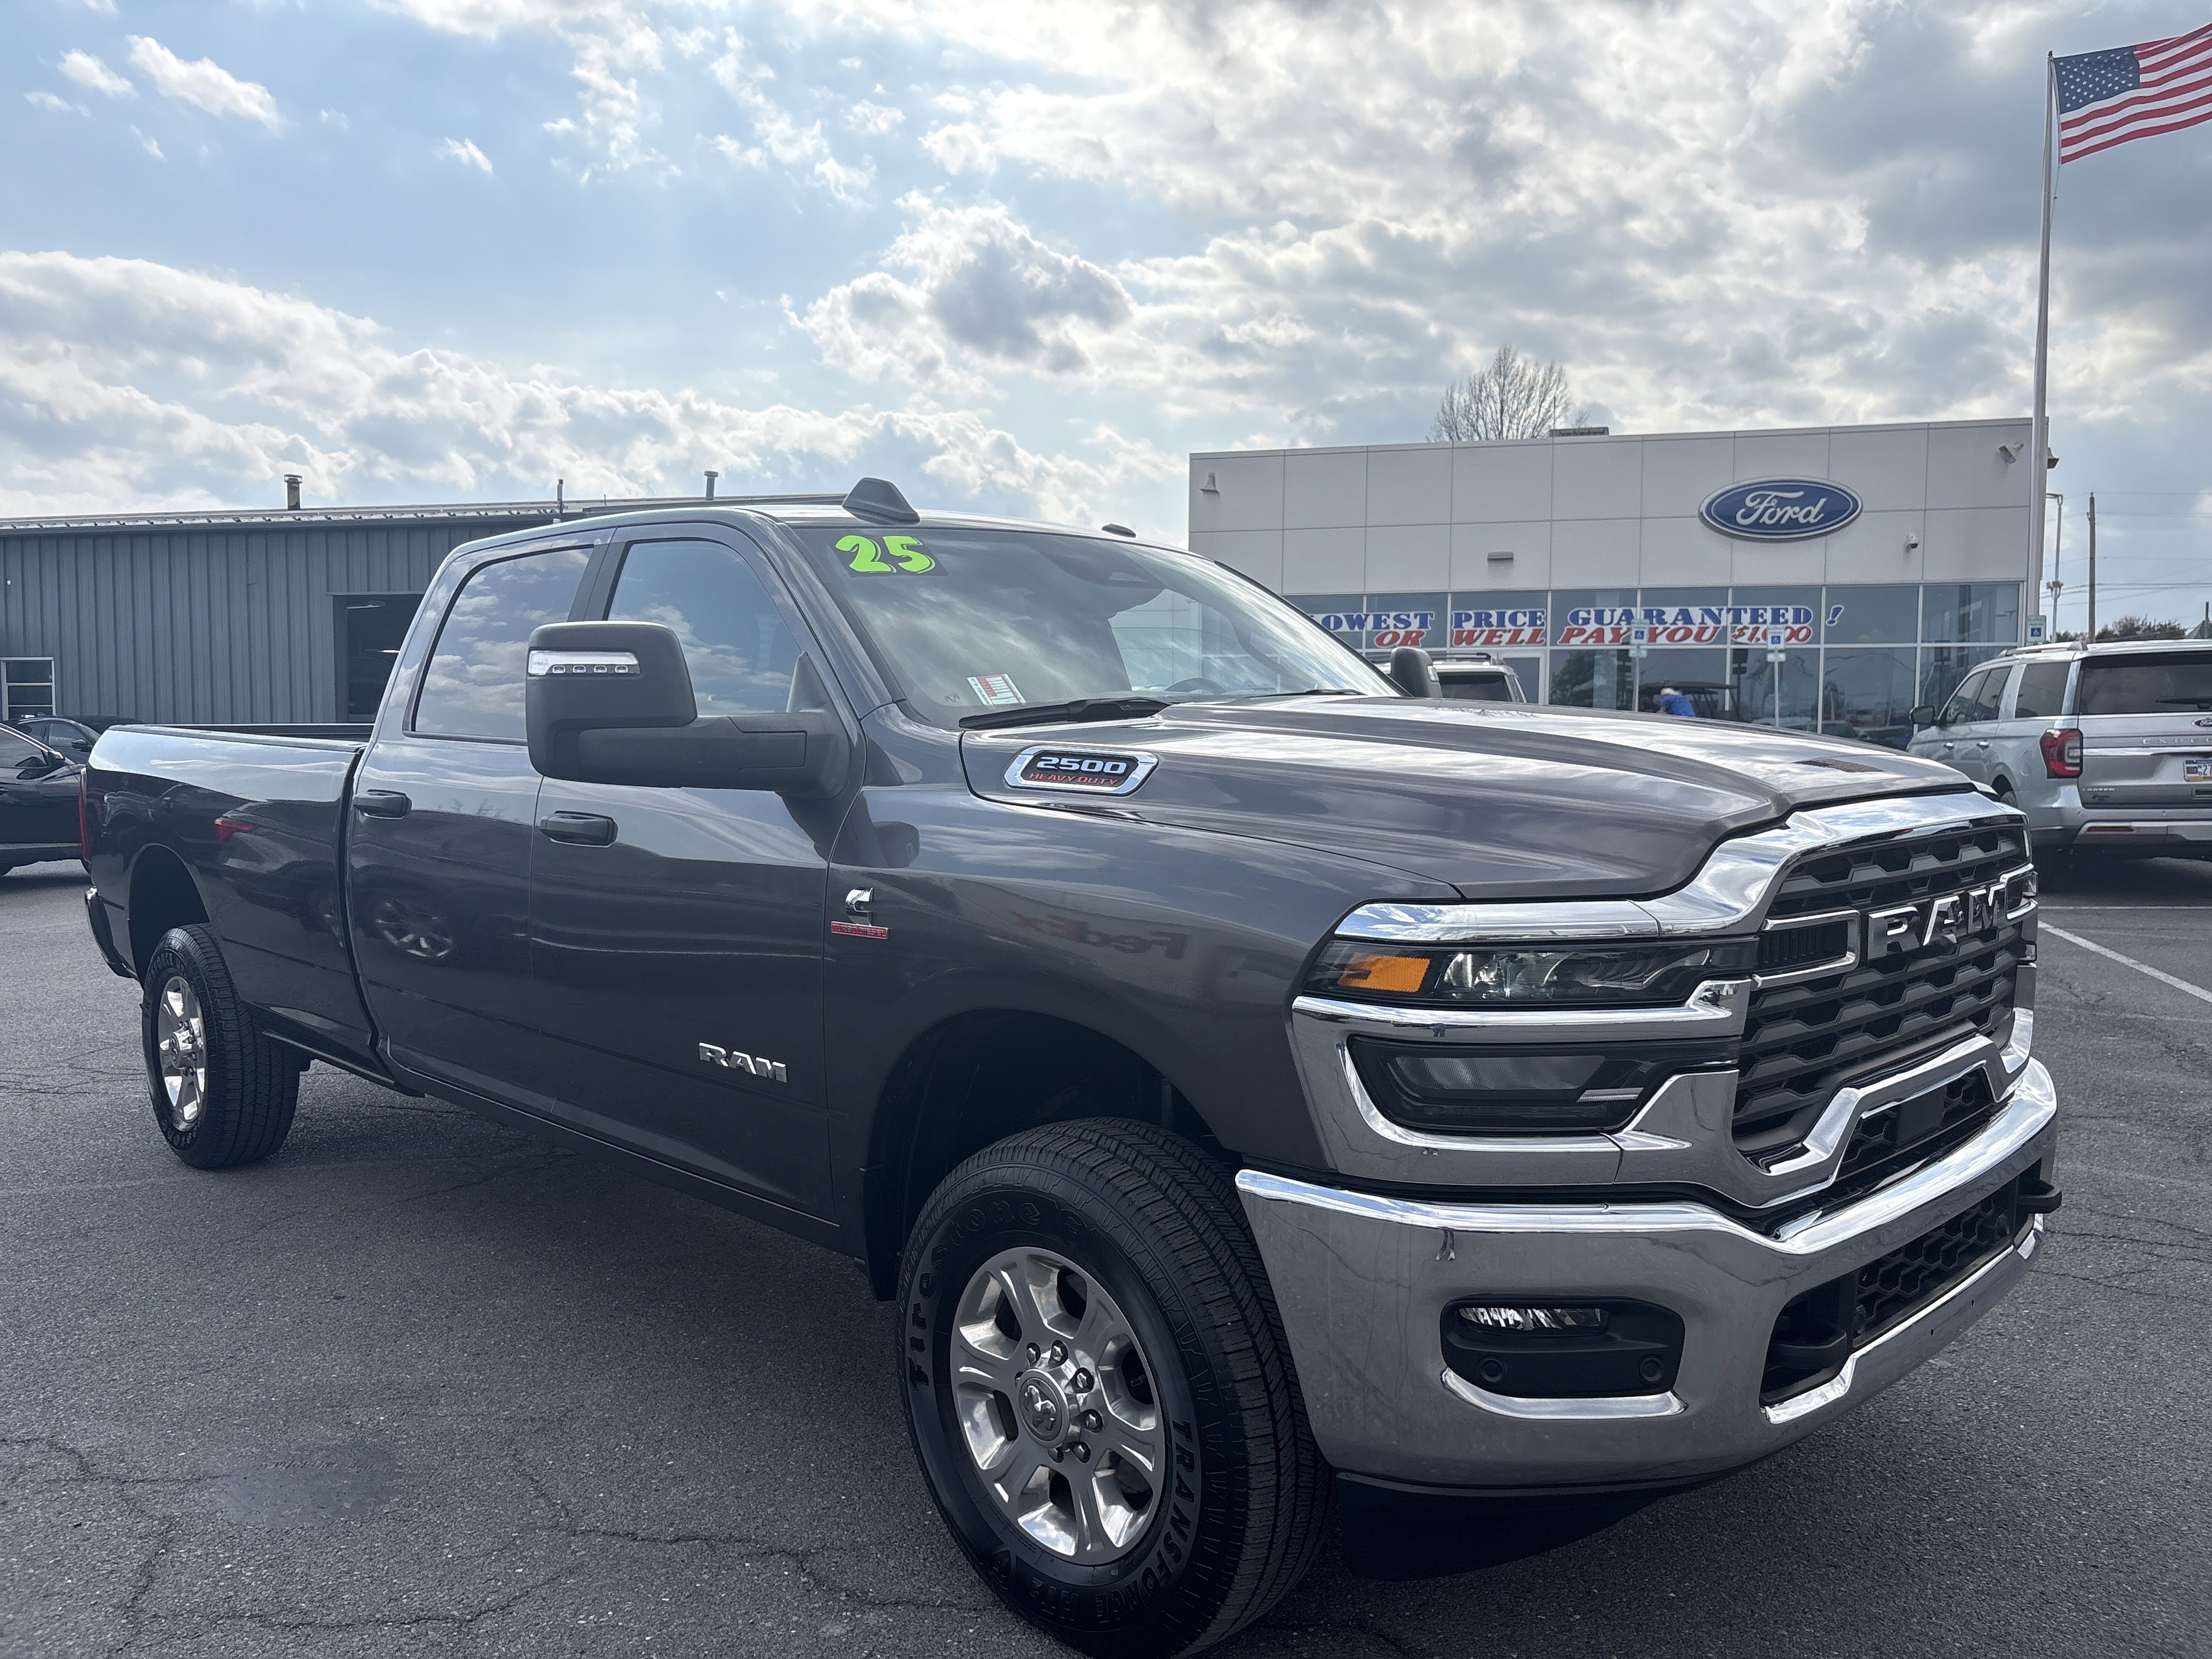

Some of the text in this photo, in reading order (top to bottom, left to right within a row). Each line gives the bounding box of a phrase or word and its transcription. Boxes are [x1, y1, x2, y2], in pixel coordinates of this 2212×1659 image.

[1736, 491, 1827, 526] Ford
[836, 535, 935, 574] 25
[1311, 611, 1434, 631] OWEST
[1452, 610, 1546, 629] PRICE
[1567, 607, 1813, 627] GUARANTEED
[1374, 630, 1426, 647] OR
[1558, 626, 1631, 645] PAY
[1647, 625, 1722, 644] YOU
[1731, 625, 1813, 644] $1,00
[1029, 772, 1120, 786] HEAVY DUTY
[1036, 756, 1127, 775] 2500
[1867, 882, 2005, 961] RAM
[698, 1041, 788, 1084] RAM
